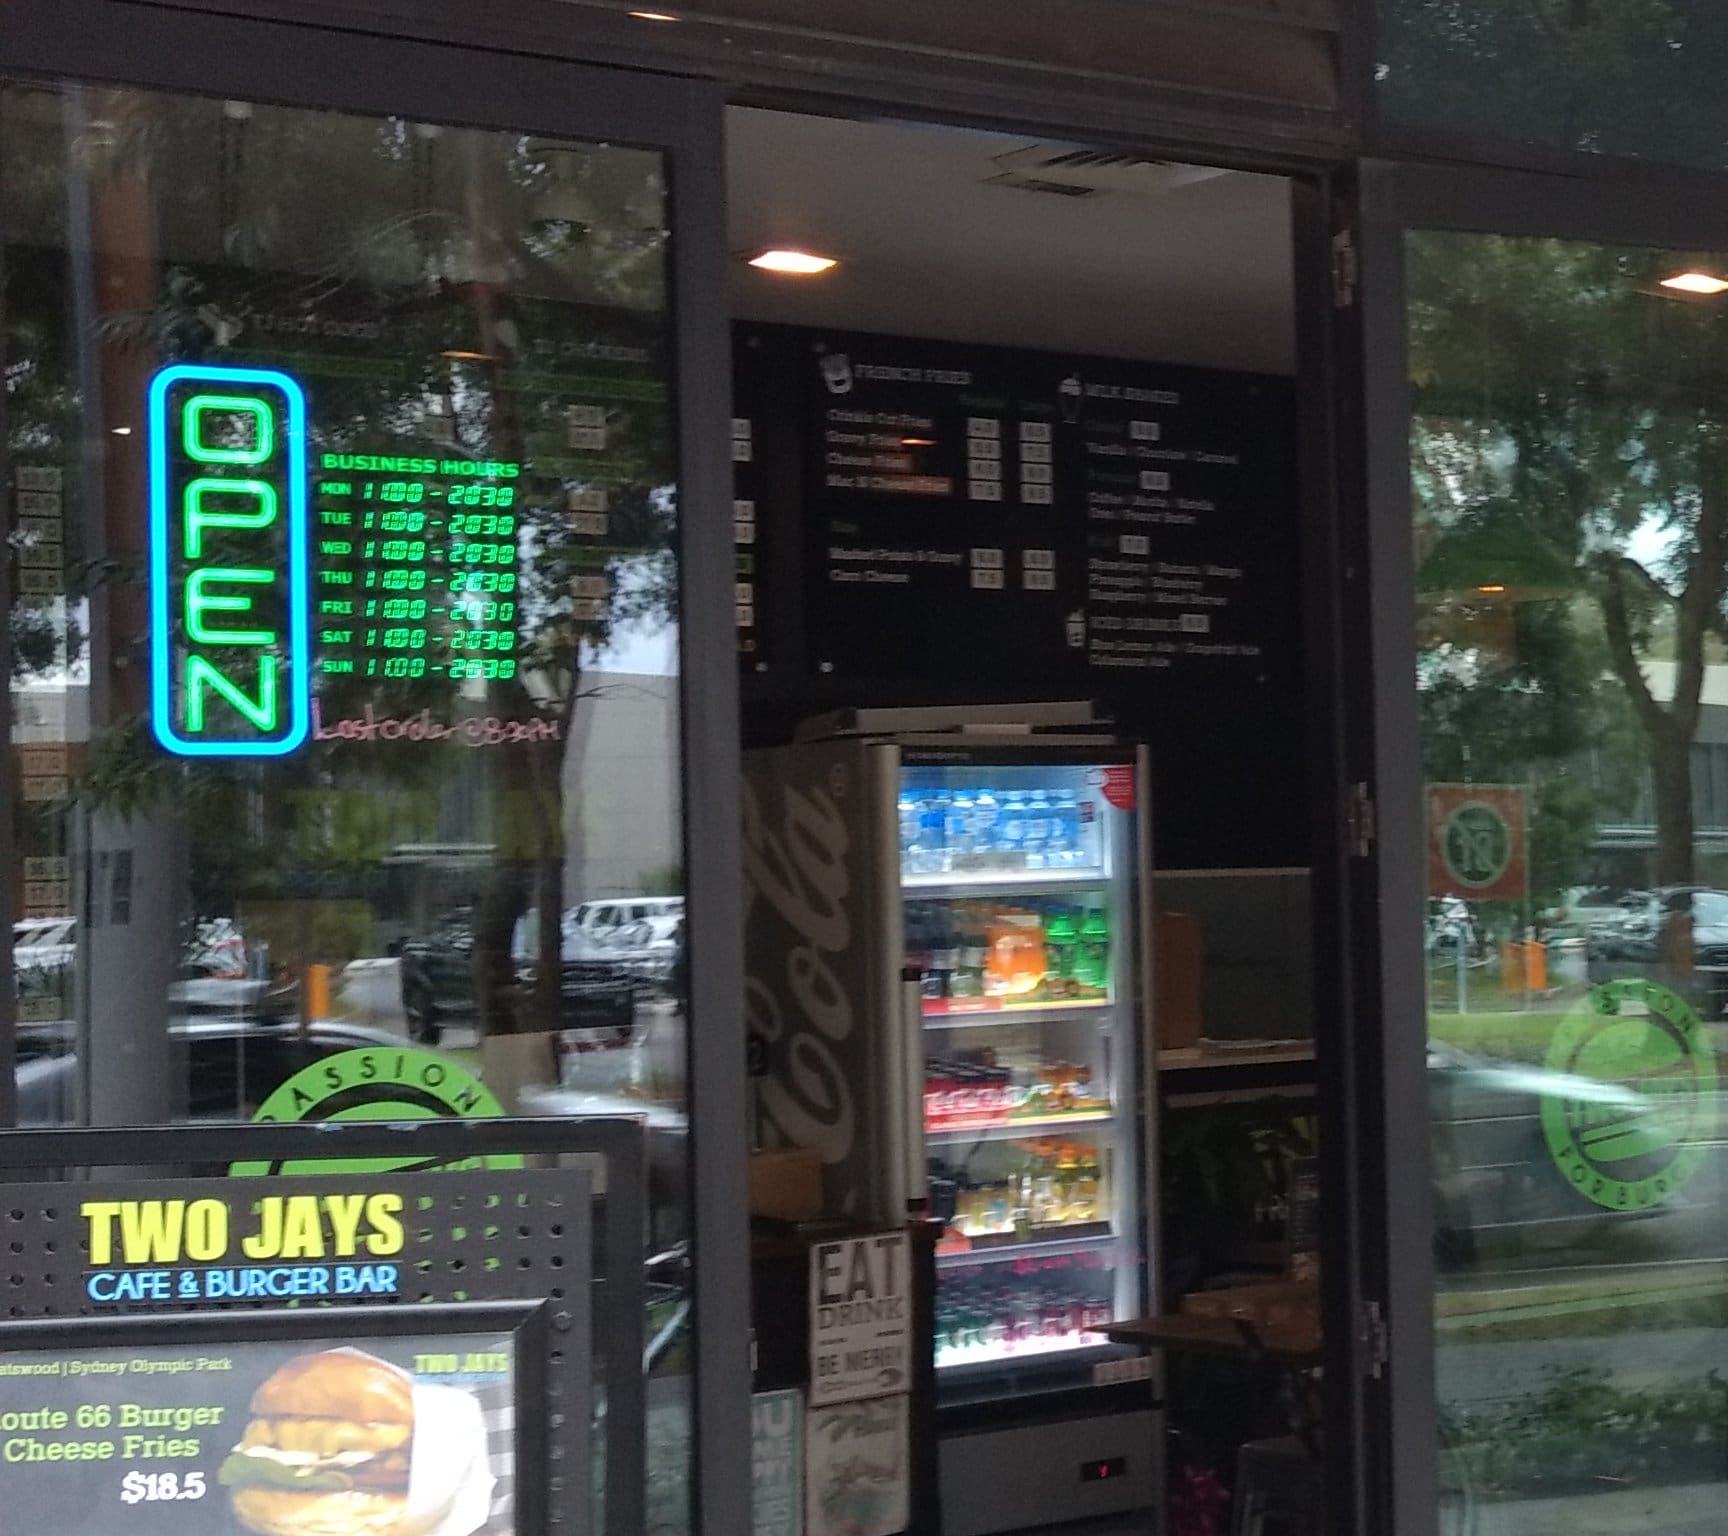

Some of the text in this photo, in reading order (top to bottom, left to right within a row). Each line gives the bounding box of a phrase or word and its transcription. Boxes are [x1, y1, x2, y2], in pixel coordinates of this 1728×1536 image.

[321, 453, 520, 478] BUSINESS HOURS
[320, 482, 352, 495] MON
[320, 511, 352, 525] TUE
[321, 541, 352, 555] WED
[182, 394, 277, 734] OPEN
[321, 571, 353, 584] THU
[321, 601, 353, 614] FRI
[321, 630, 353, 643] SAT
[322, 660, 353, 673] SUN
[80, 1193, 405, 1265] TWO JAYS
[818, 1235, 905, 1306] EAT
[87, 1265, 398, 1301] CAFE & BURGER BAR
[68, 1360, 128, 1376] Sydney
[129, 1358, 194, 1375] Olympic
[195, 1356, 233, 1371] Park
[0, 1403, 226, 1432] oute 66 Burger
[4, 1434, 201, 1463] Cheese Fries
[119, 1470, 207, 1507] $18.5
